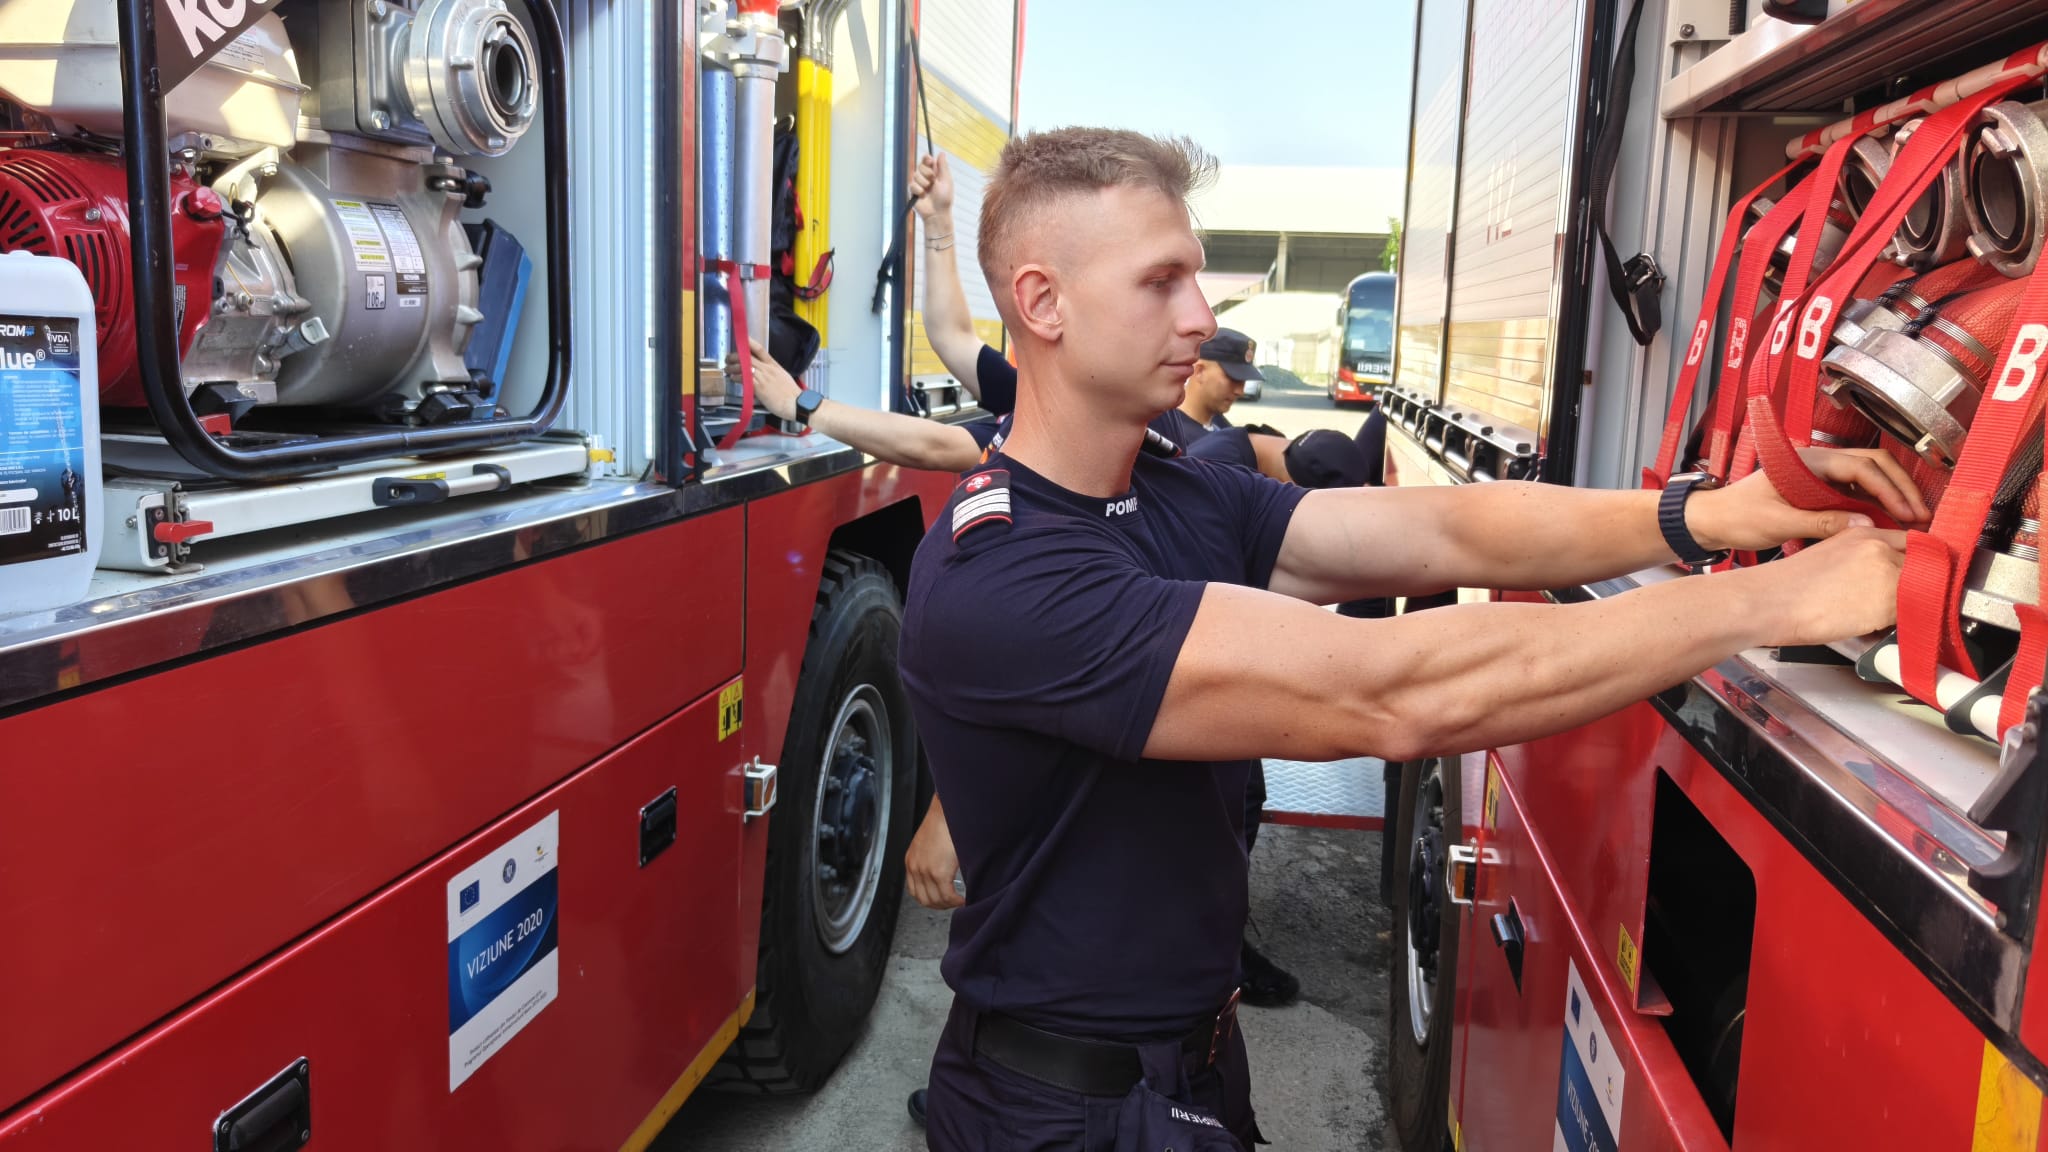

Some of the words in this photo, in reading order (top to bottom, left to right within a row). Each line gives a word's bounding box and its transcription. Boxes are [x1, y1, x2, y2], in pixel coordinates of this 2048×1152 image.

[1687, 319, 1708, 366] B
[1797, 296, 1833, 360] B
[1992, 323, 2048, 402] B
[466, 928, 514, 980] VIZIUNE
[517, 907, 543, 943] 2020
[1567, 1072, 1589, 1145] VIZIUNE
